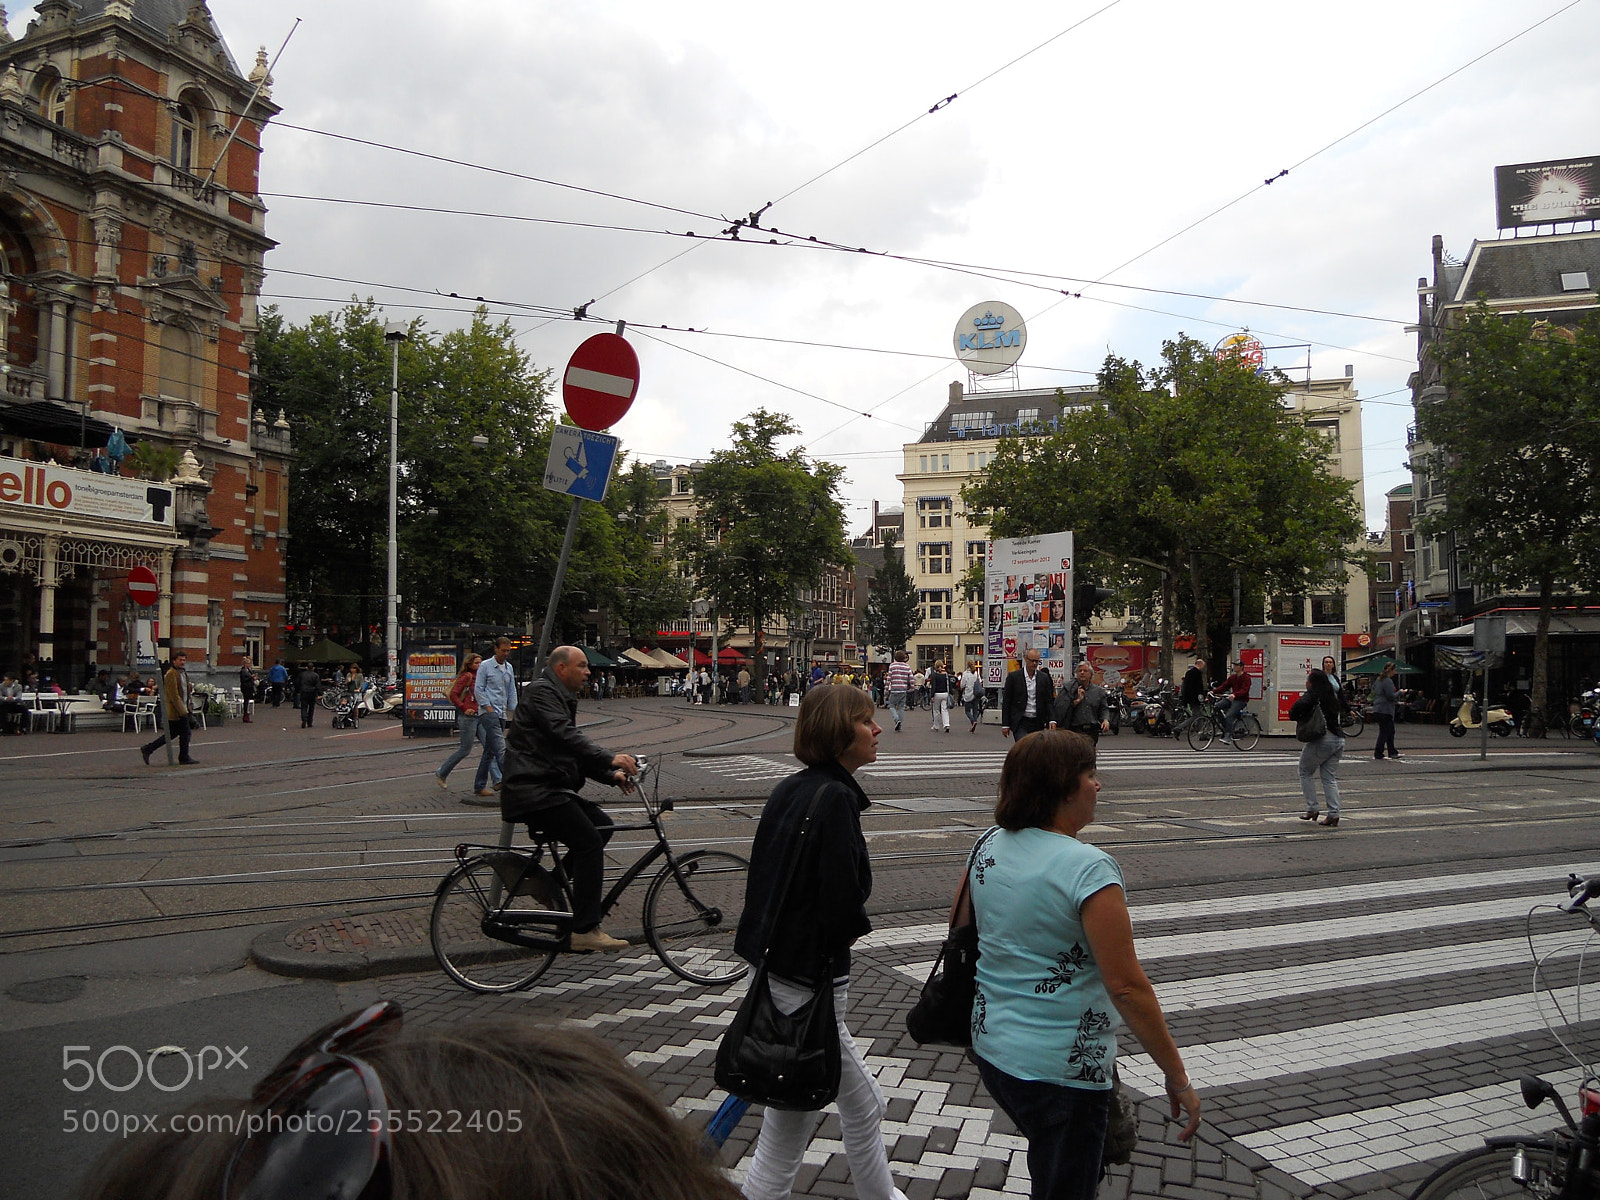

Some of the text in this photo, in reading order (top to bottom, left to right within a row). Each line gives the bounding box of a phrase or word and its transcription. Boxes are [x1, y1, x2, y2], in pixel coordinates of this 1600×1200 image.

[1510, 204, 1538, 212] THE
[959, 330, 1020, 350] KLM
[1018, 558, 1038, 566] september
[408, 656, 456, 666] COMPUTER
[990, 668, 1000, 676] 50
[424, 710, 456, 720] SATURN
